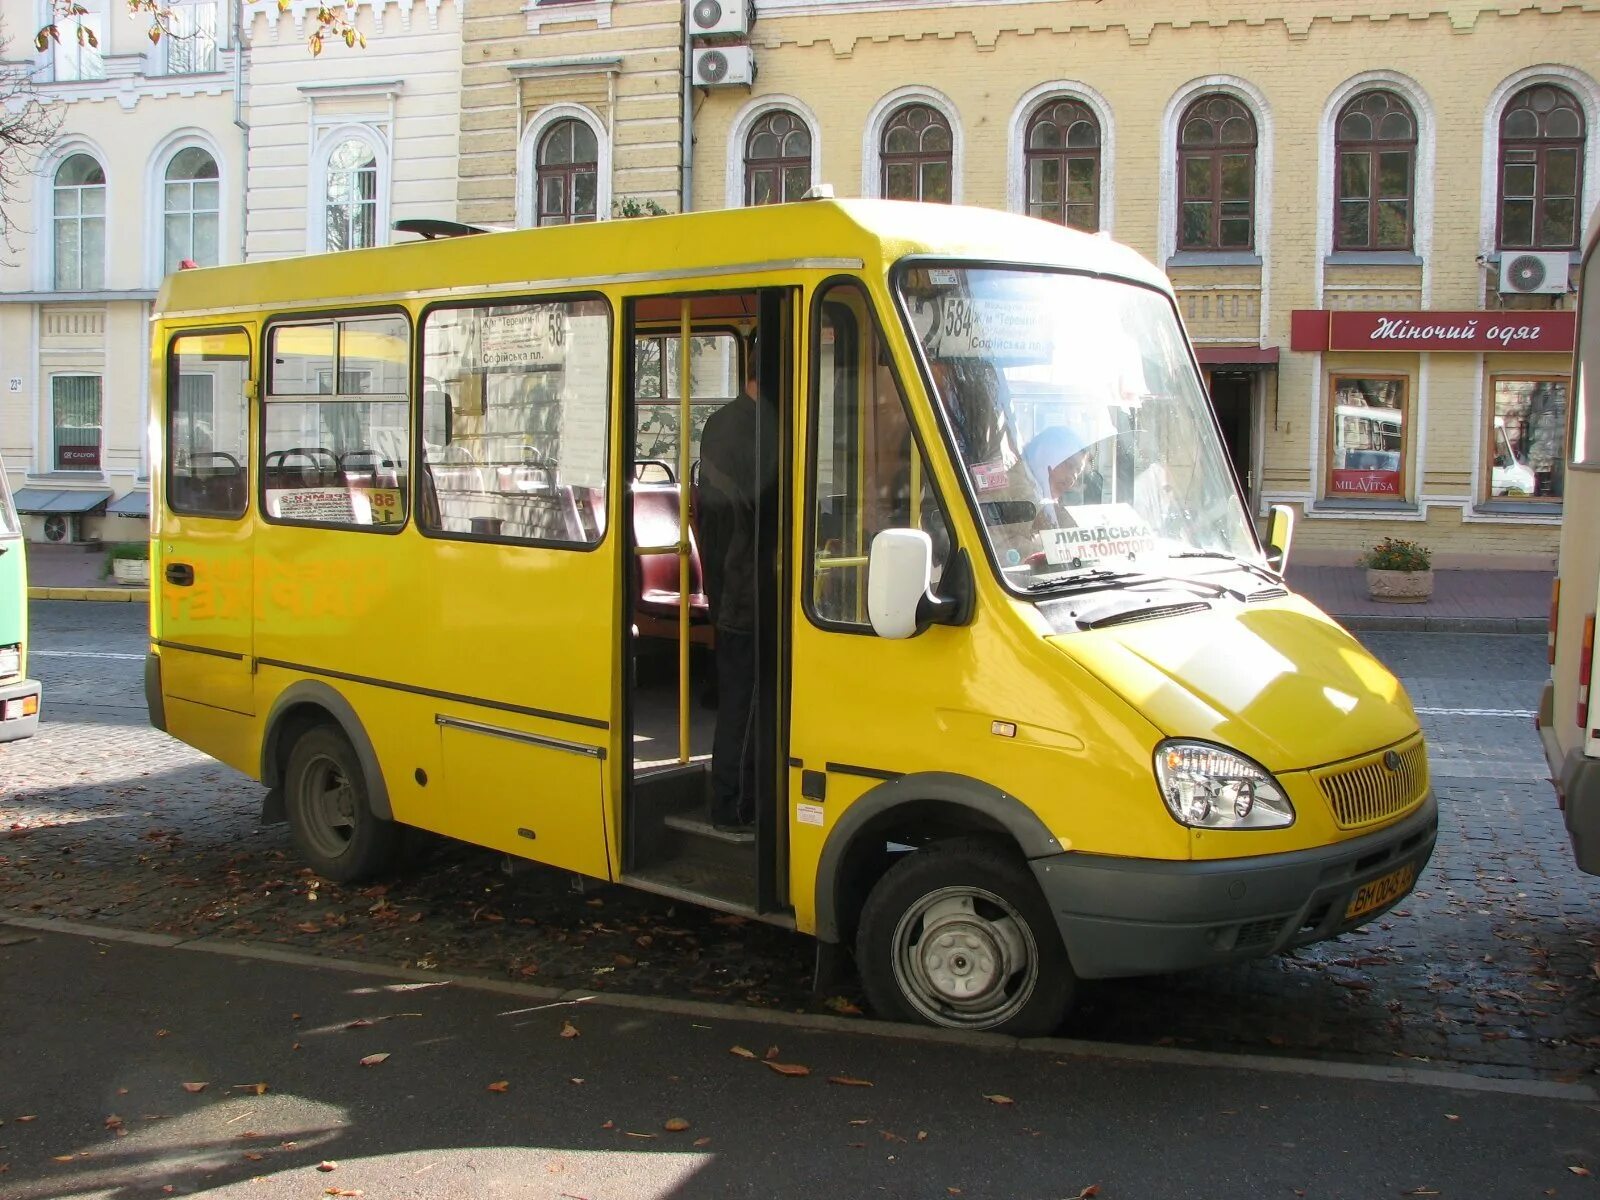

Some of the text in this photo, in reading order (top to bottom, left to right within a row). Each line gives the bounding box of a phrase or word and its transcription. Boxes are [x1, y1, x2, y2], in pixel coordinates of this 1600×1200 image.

[945, 300, 972, 338] 584
[1370, 317, 1541, 346] Жіночий одяг
[483, 351, 544, 364] Софійська пл.
[1335, 476, 1395, 492] MILAVITSA
[1055, 525, 1150, 545] ЛИБІДСЬКА
